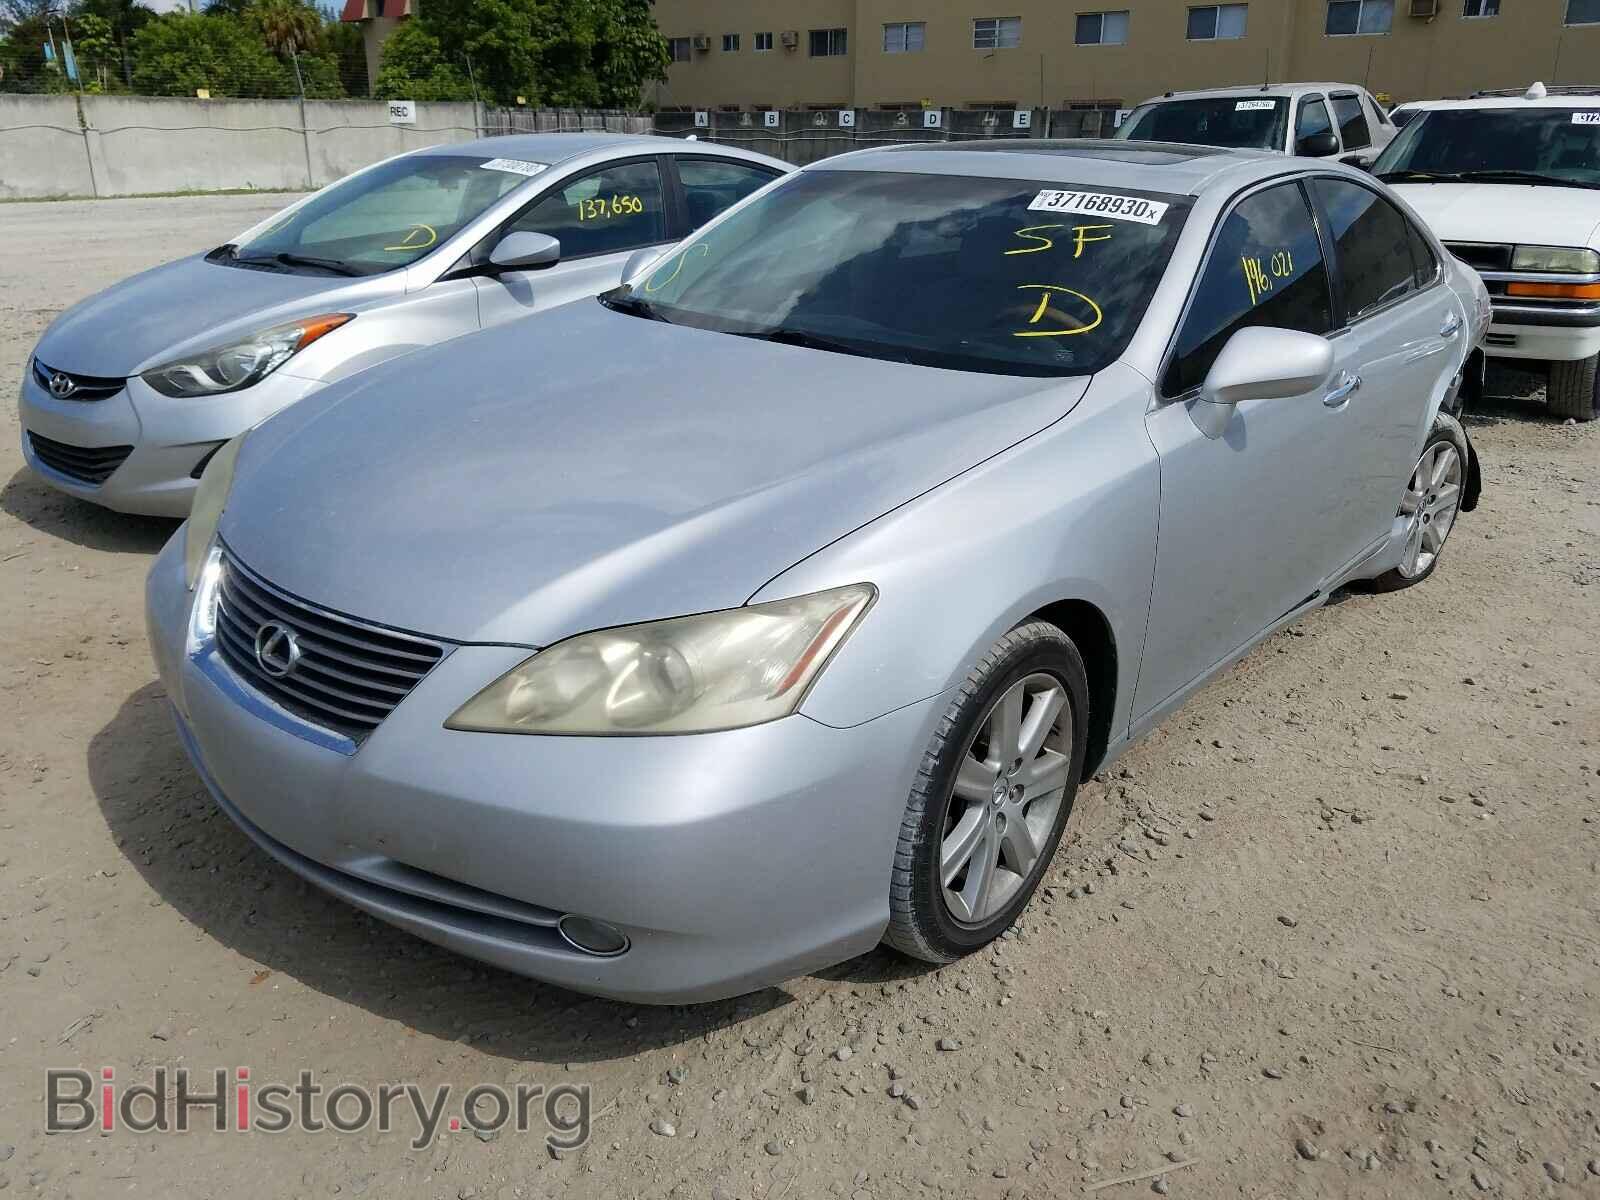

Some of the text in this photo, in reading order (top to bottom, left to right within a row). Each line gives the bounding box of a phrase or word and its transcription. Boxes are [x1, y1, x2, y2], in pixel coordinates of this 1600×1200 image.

[390, 106, 408, 117] REC
[697, 114, 705, 124] A
[768, 114, 775, 124] B
[843, 113, 850, 124] C
[929, 114, 937, 124] D
[1019, 114, 1026, 124] E
[579, 194, 643, 221] 137,650
[384, 223, 437, 251] D
[1003, 224, 1115, 258] S F
[1013, 284, 1103, 337] D
